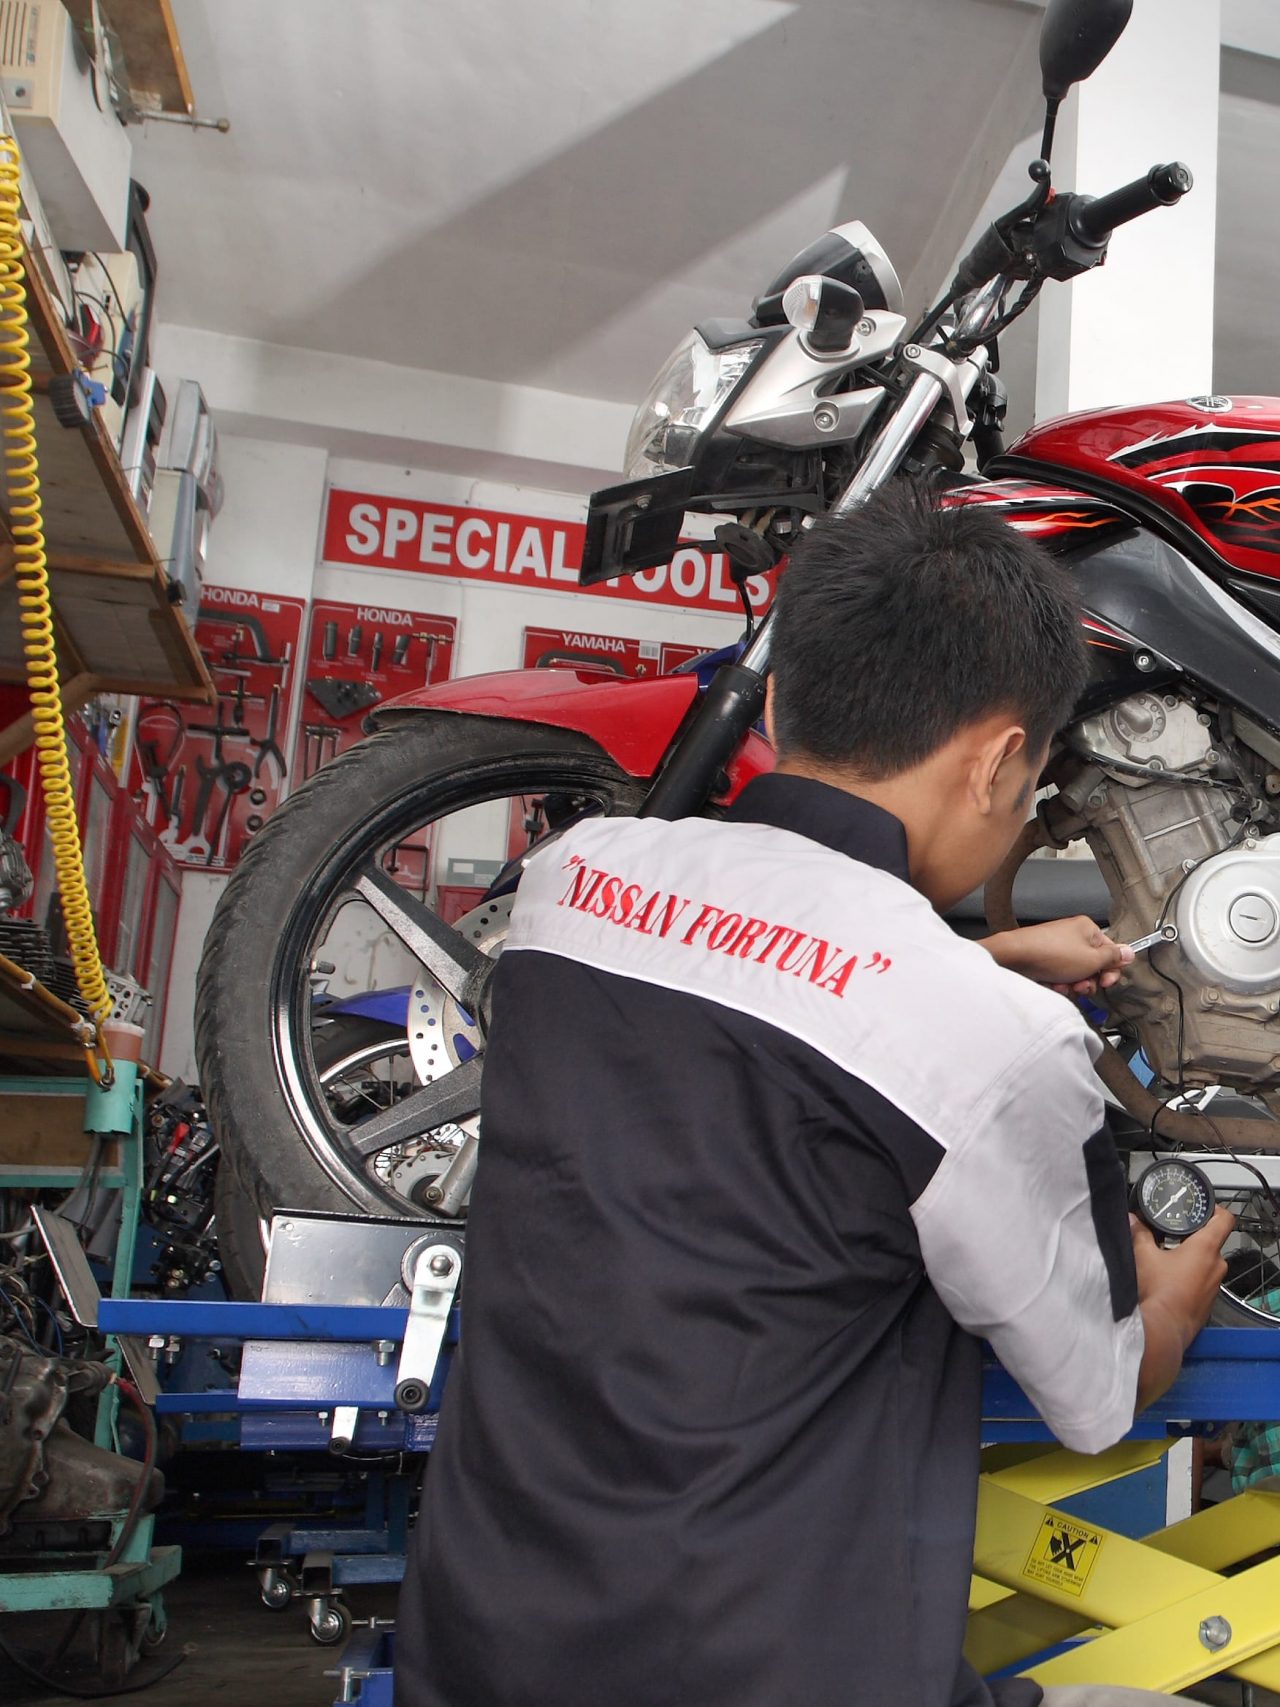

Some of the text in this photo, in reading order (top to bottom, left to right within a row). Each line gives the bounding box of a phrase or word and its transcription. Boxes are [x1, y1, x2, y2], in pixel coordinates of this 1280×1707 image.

[345, 503, 769, 606] SPECIAL OOLS
[201, 587, 259, 608] HONDA
[357, 607, 413, 627] HONDA
[562, 632, 626, 653] YAMAHA
[1057, 1522, 1089, 1540] CAUTION
